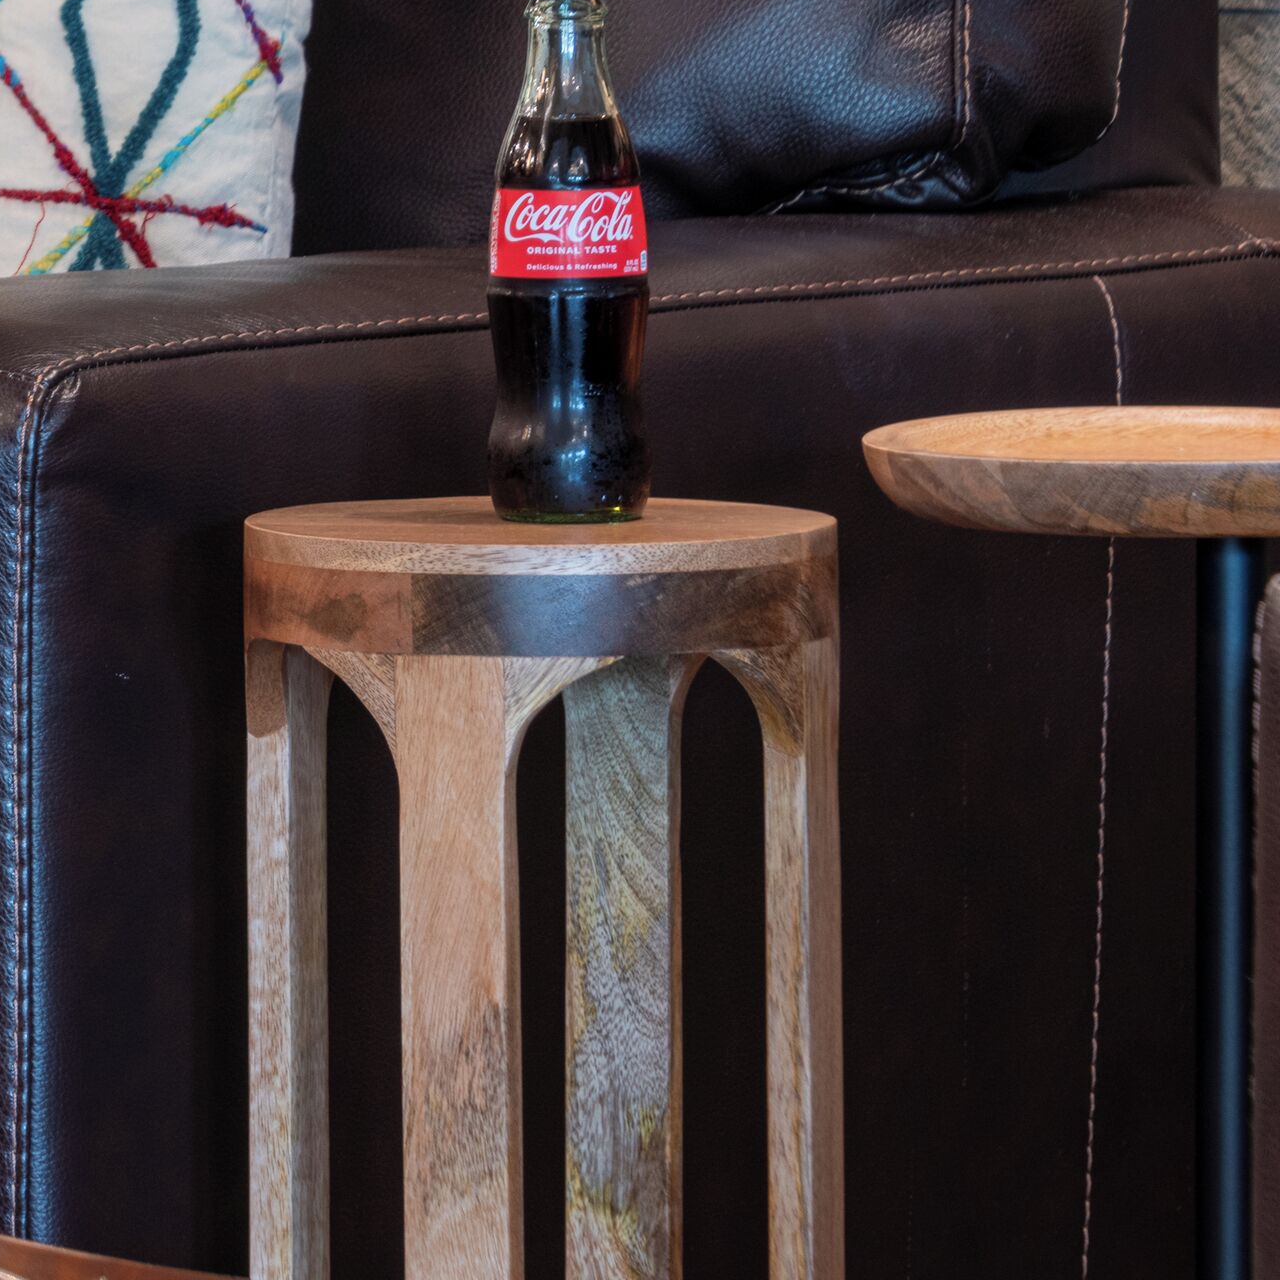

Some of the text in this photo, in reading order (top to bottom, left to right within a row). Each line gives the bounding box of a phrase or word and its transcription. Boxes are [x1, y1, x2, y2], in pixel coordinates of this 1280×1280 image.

[504, 190, 633, 243] Coca-Cola
[527, 245, 617, 255] ORIGINAL TASTE
[574, 262, 618, 271] Refreshing
